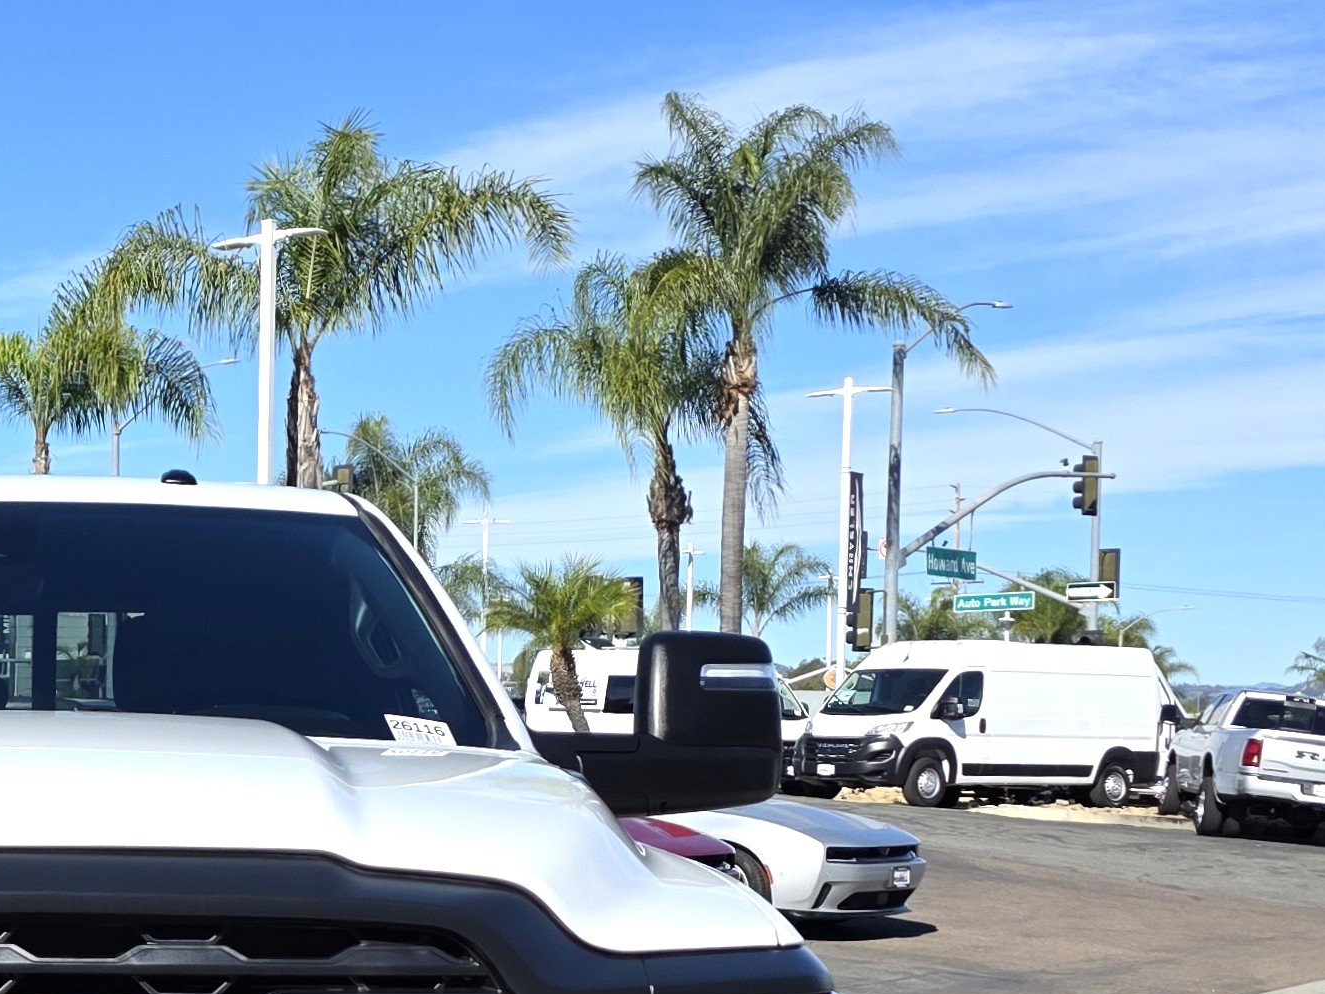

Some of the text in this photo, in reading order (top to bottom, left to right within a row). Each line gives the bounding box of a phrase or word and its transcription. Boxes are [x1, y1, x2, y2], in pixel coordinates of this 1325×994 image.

[928, 553, 975, 574] Howard Ave
[957, 596, 1031, 608] Auto Park Way
[390, 720, 445, 736] 26116
